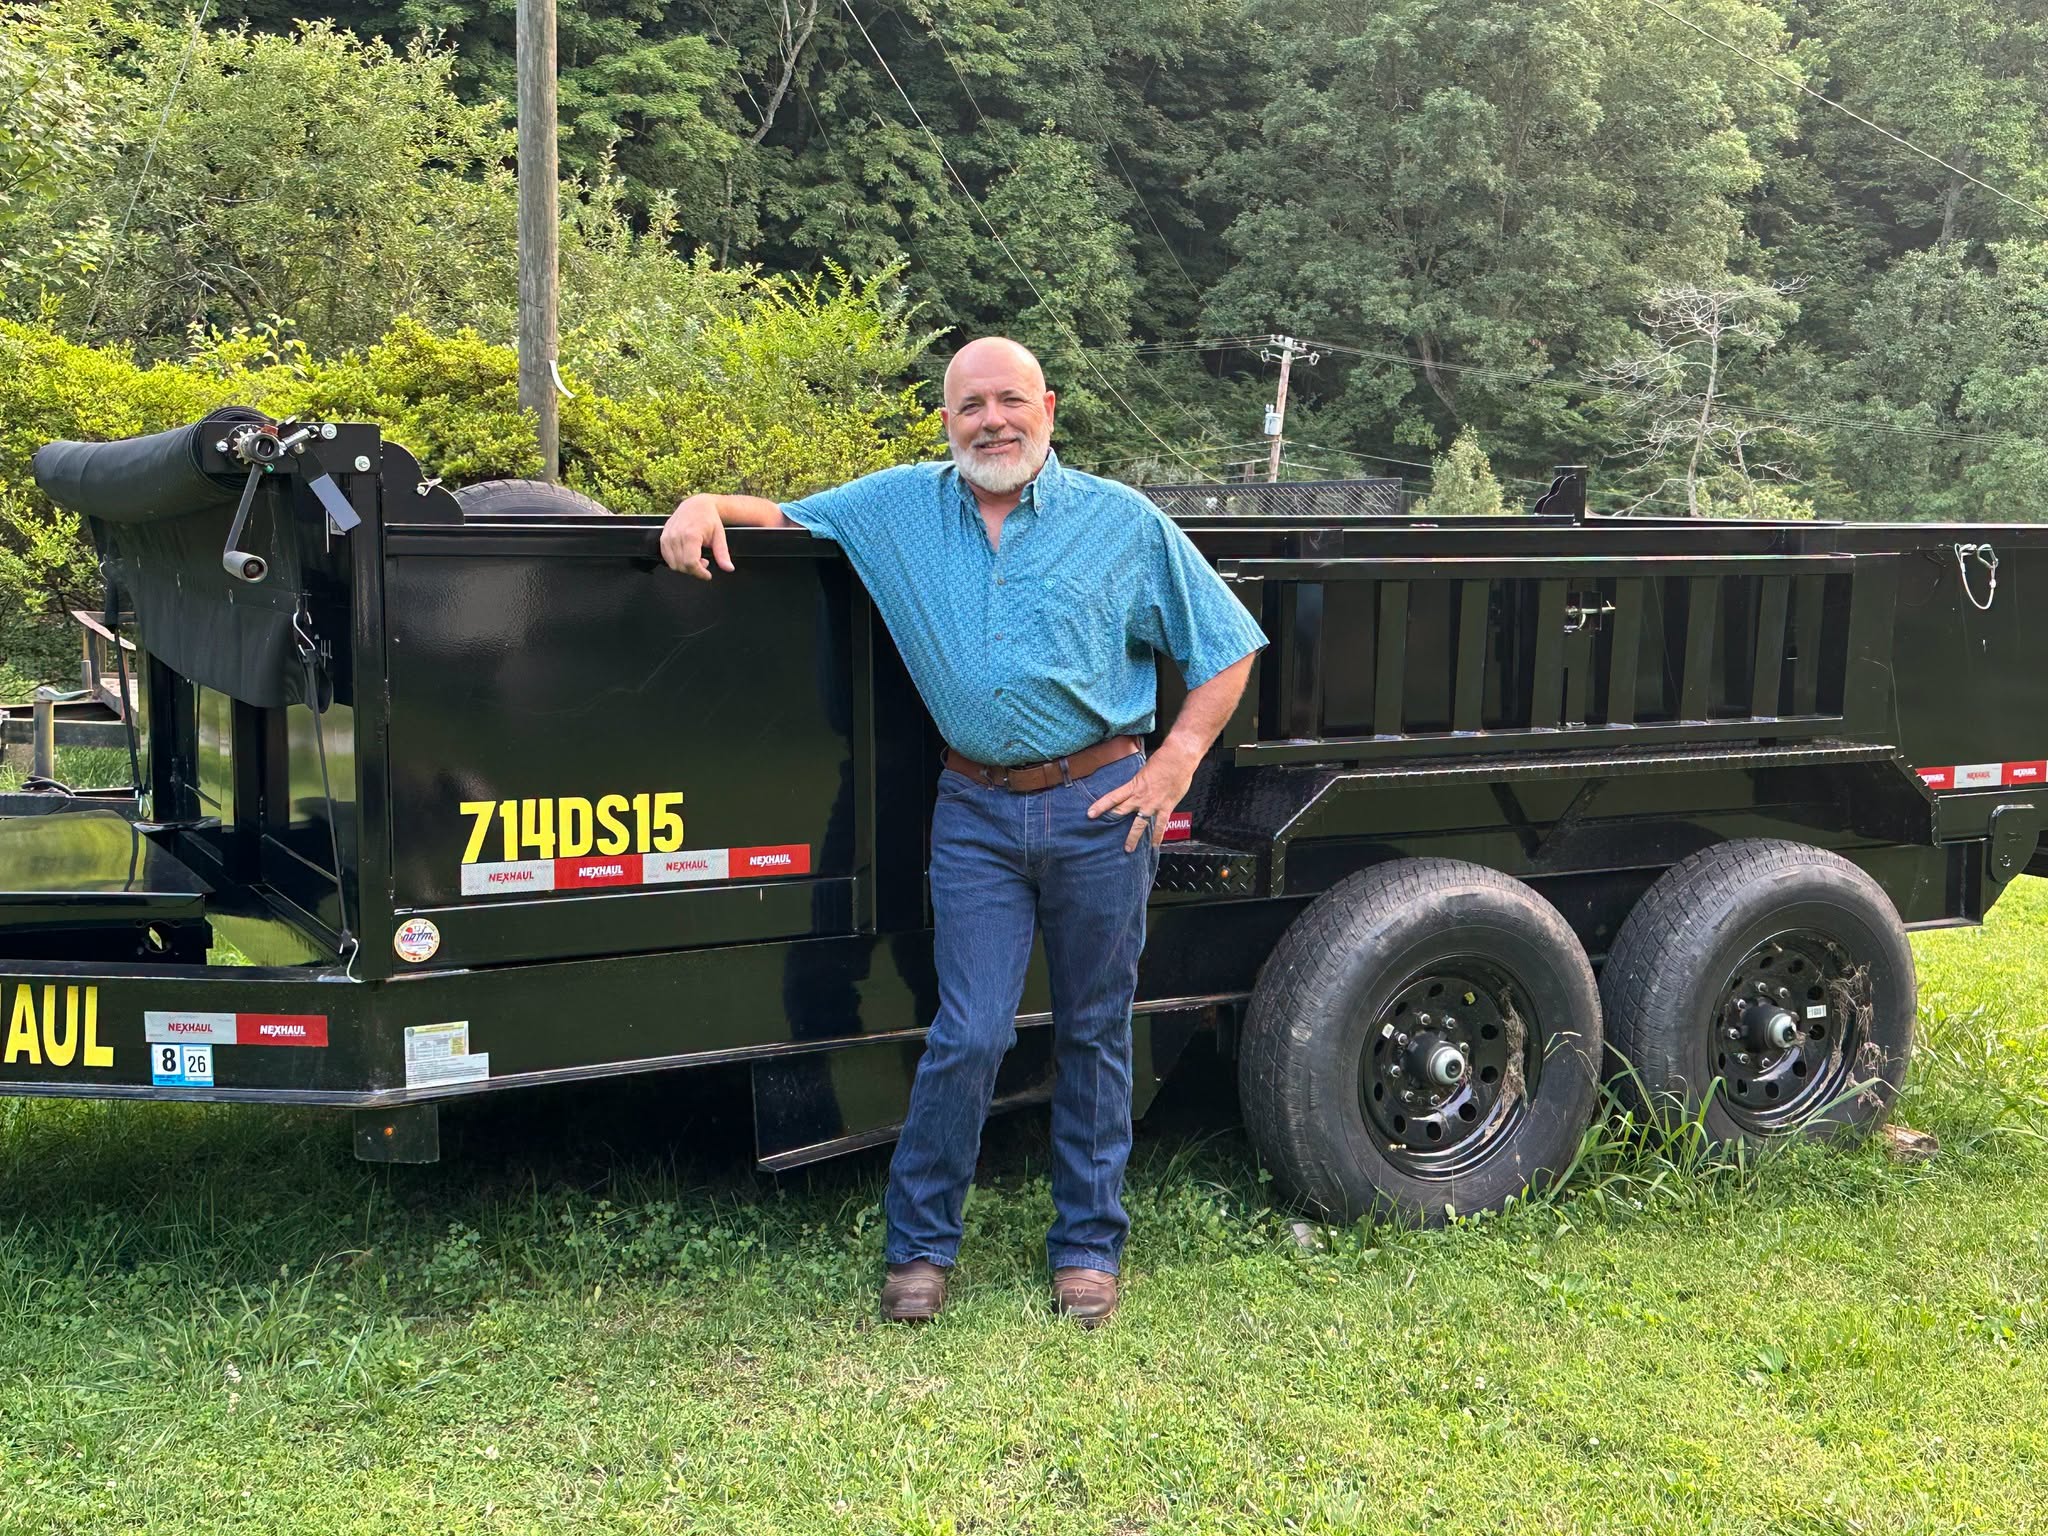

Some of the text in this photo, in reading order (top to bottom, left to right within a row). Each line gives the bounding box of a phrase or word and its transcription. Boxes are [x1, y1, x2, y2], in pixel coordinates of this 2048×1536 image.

[459, 791, 684, 864] 714DS15
[1166, 819, 1190, 831] XHAUL
[488, 853, 791, 884] NEXHAUL NEXHAUL NEXHAUL NEXHAUL
[0, 983, 114, 1067] AUL
[168, 1022, 306, 1037] NEXHAUL NEXHAUL
[162, 1047, 176, 1072] 8
[188, 1055, 206, 1073] 26
